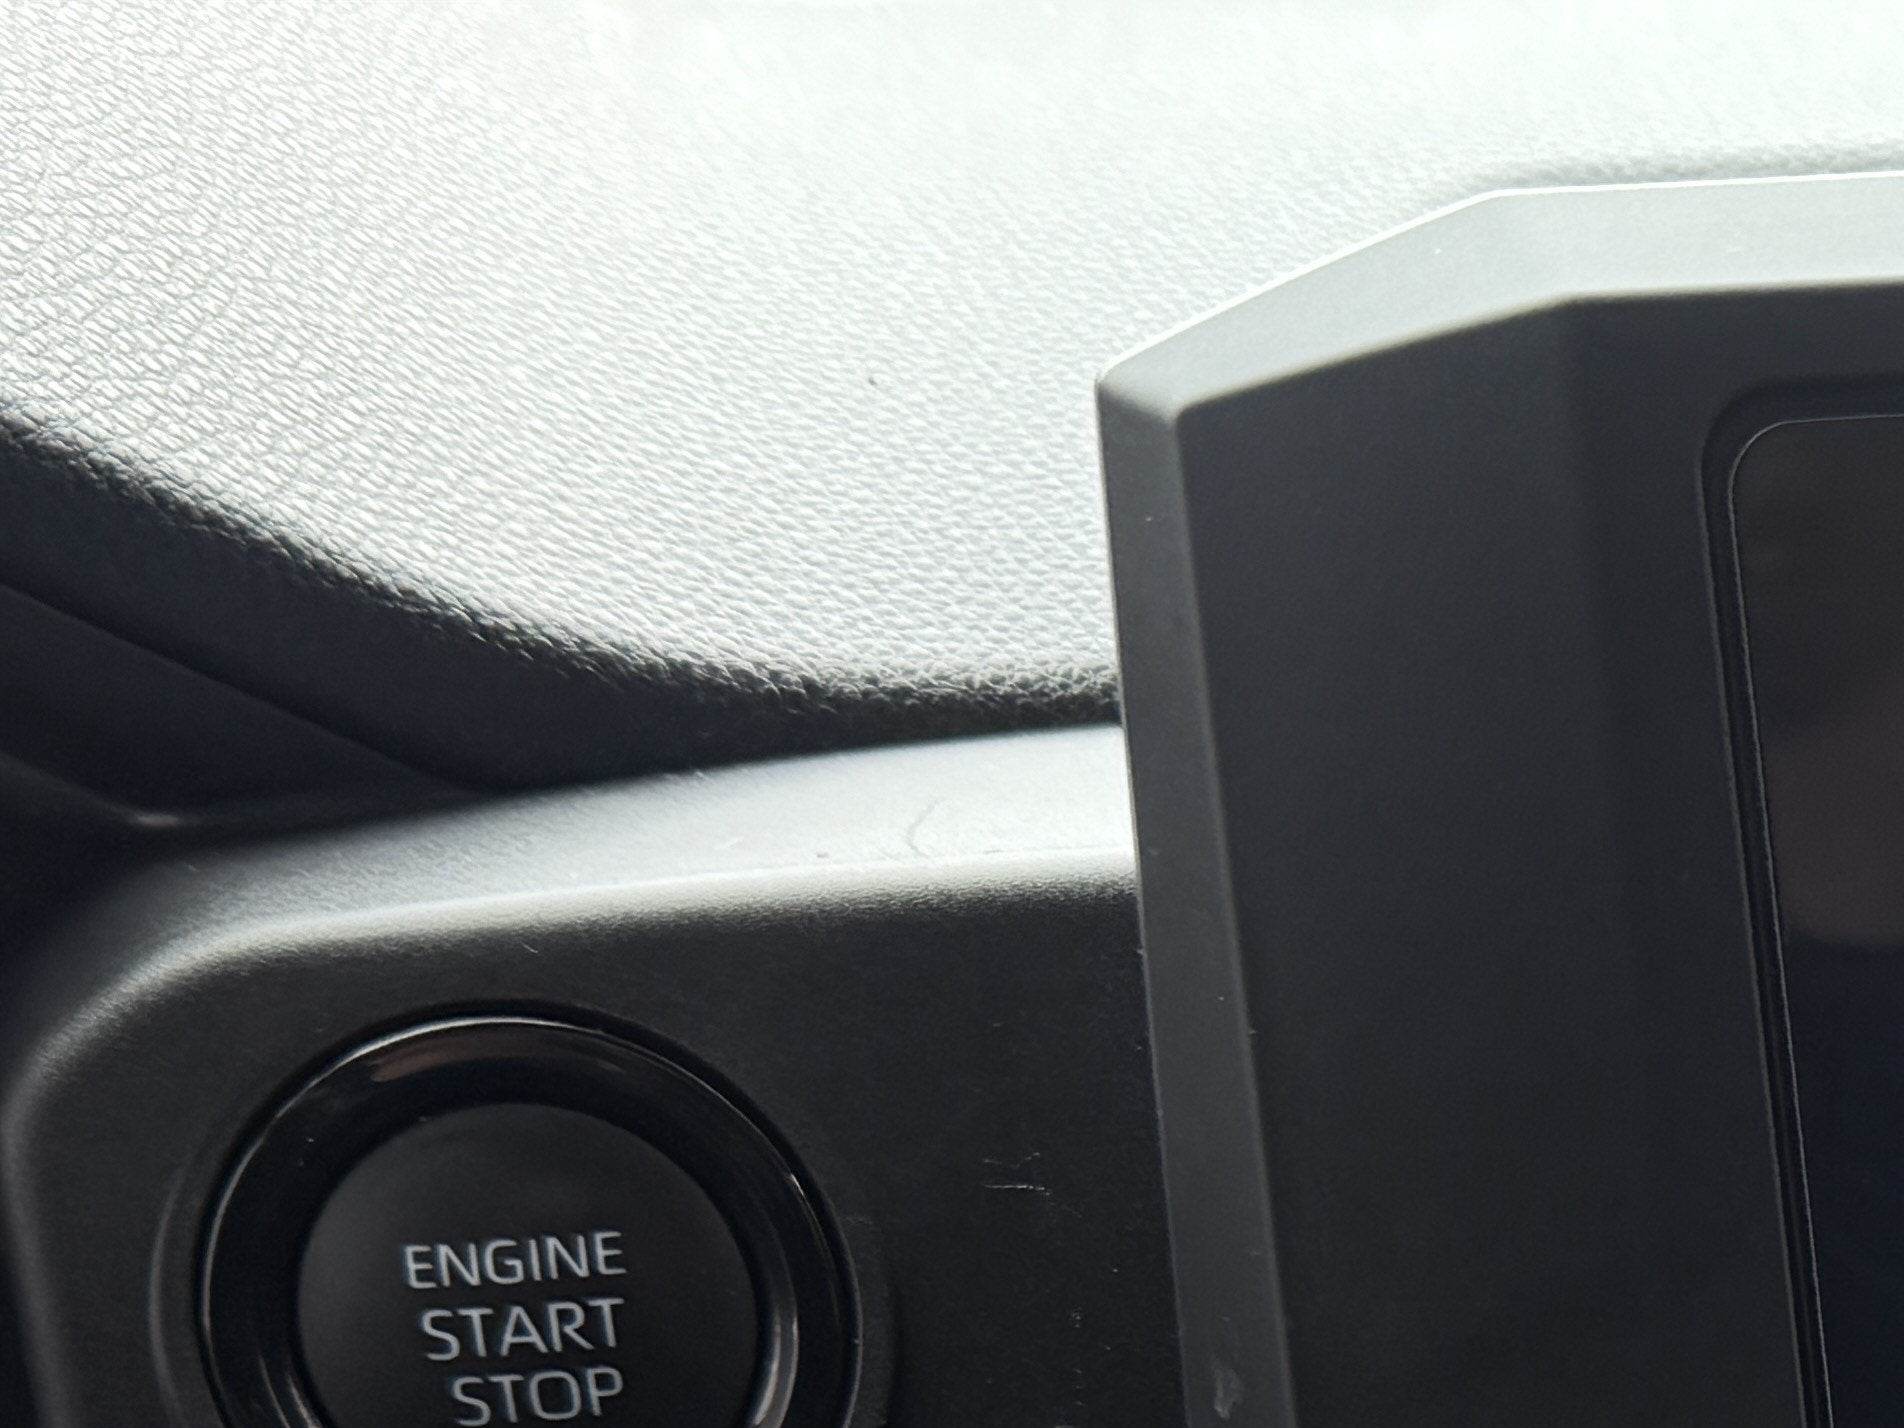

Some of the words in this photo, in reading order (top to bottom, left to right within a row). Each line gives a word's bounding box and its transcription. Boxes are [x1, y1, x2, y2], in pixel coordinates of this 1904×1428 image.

[403, 1230, 627, 1290] ENGINE
[420, 1297, 625, 1362] START
[450, 1364, 625, 1428] STOP
